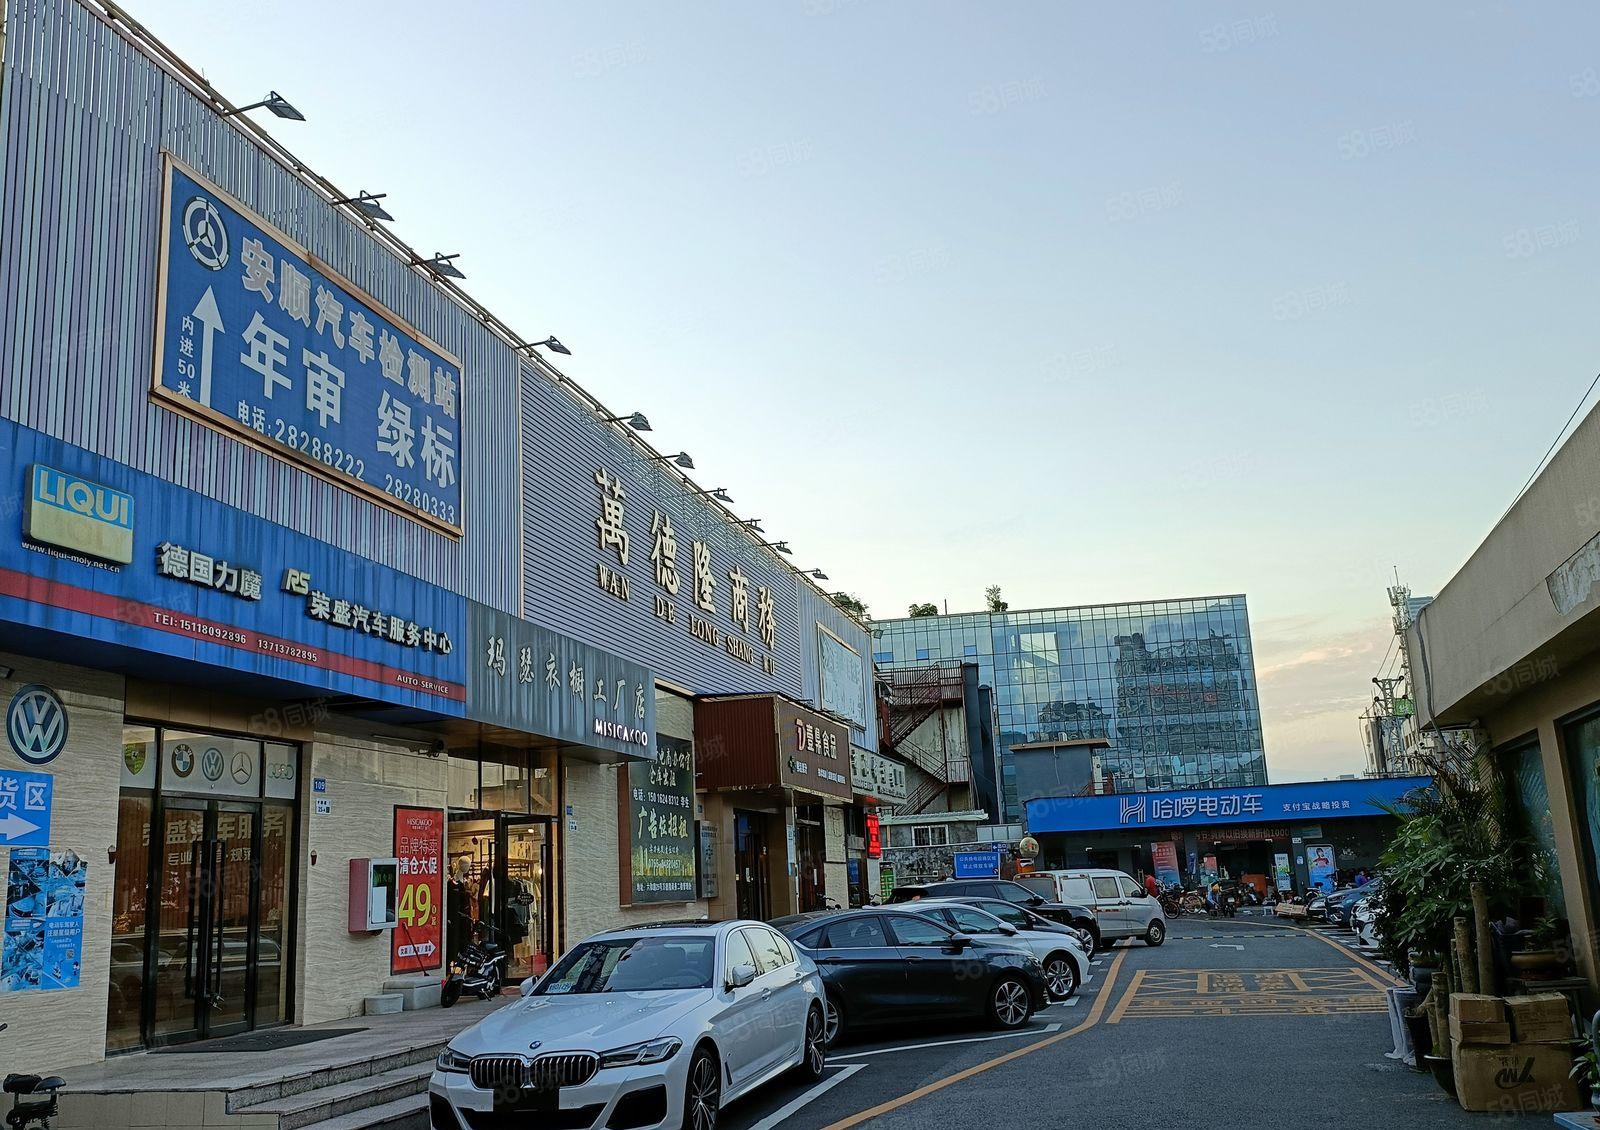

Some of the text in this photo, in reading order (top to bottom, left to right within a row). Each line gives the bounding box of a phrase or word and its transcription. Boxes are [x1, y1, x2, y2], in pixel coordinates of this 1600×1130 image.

[240, 236, 457, 420] 安顺汽车检测站
[240, 311, 457, 489] 年审 绿标
[39, 469, 129, 525] LIQUI
[384, 473, 456, 525] 28280333
[159, 541, 262, 600] 德国力魔
[595, 467, 776, 650] 萬德隆商務
[309, 590, 453, 655] 荣盛汽车服务中心
[598, 563, 631, 601] WAN
[654, 595, 676, 624] DE
[689, 613, 720, 647] LONG
[726, 635, 755, 665] SHANG
[257, 640, 318, 662] 13713782895
[595, 718, 648, 746] MISICAKOO
[1152, 793, 1264, 819] 哈啰电动车
[1282, 800, 1351, 812] 支付宝战略投资
[400, 856, 438, 875] 清仓大促
[398, 883, 432, 927] 49
